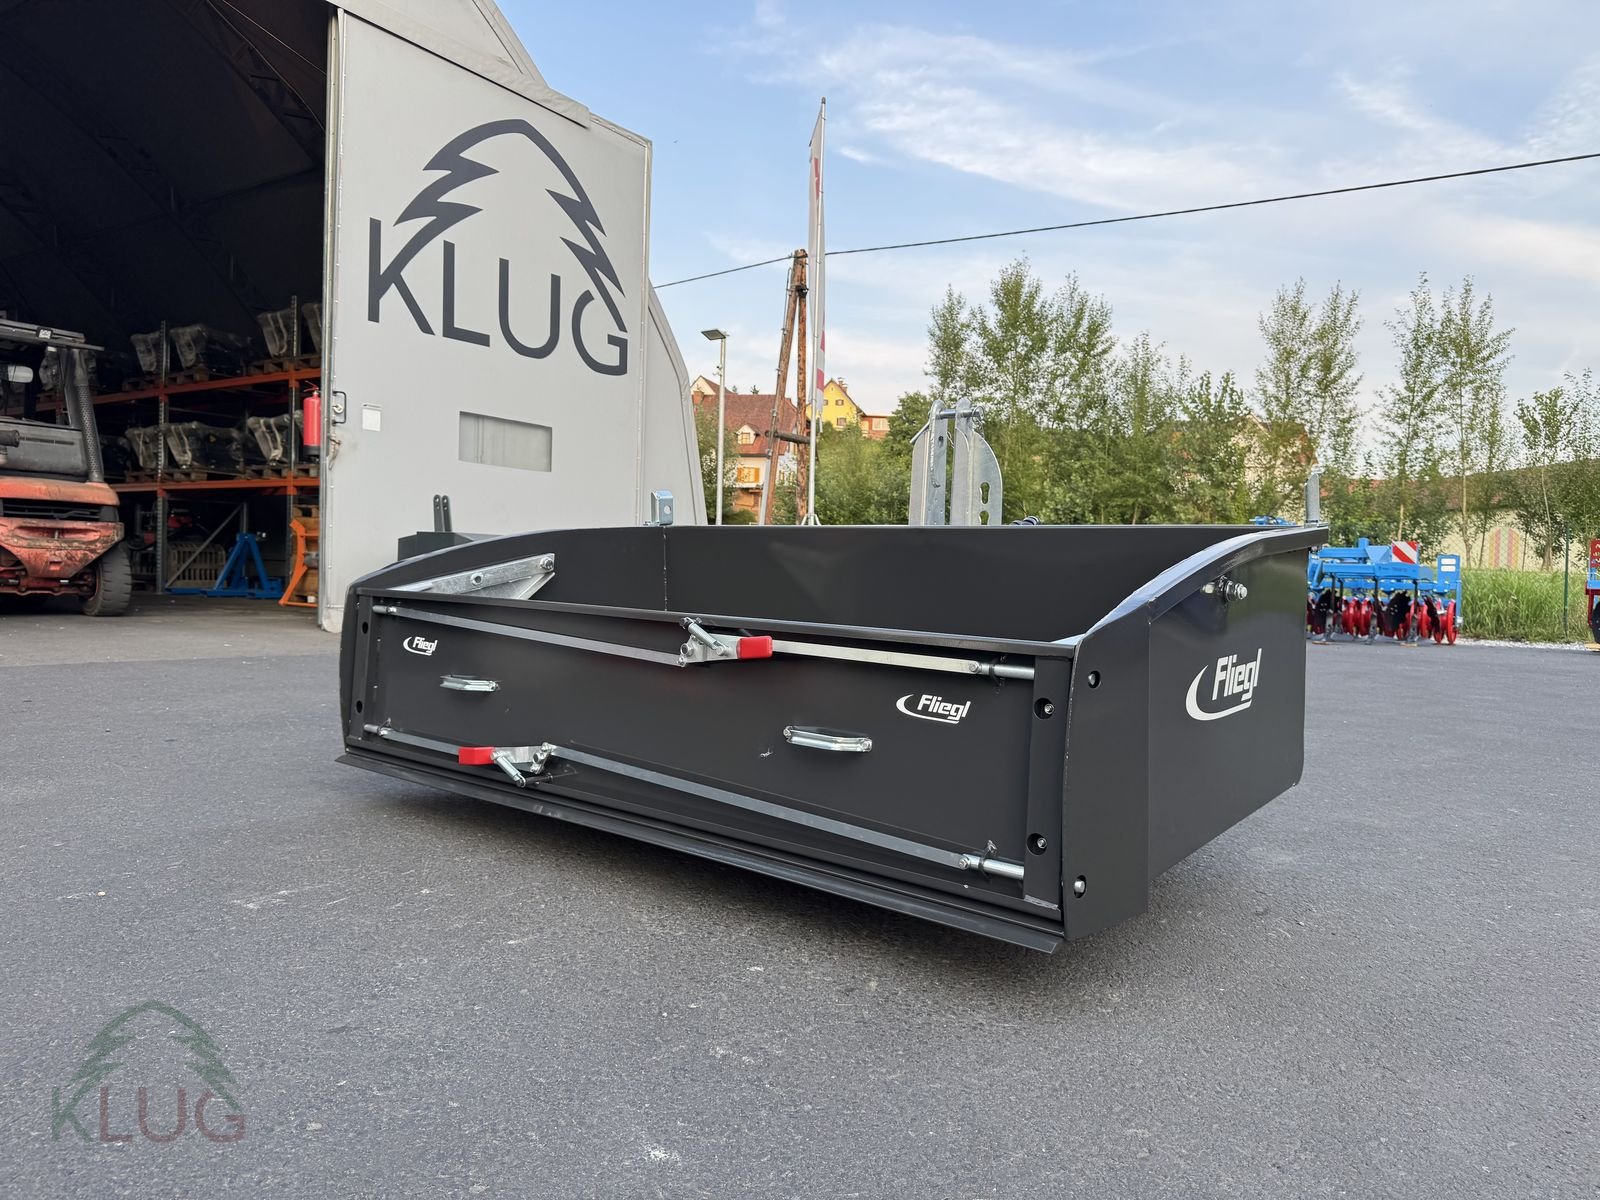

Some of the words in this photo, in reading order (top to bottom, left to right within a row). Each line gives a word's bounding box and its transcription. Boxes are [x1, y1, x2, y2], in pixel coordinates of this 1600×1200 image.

[368, 217, 628, 376] KLUG
[412, 636, 438, 653] Fliegl
[1211, 647, 1262, 701] Fliegl
[917, 694, 971, 720] Fliegl
